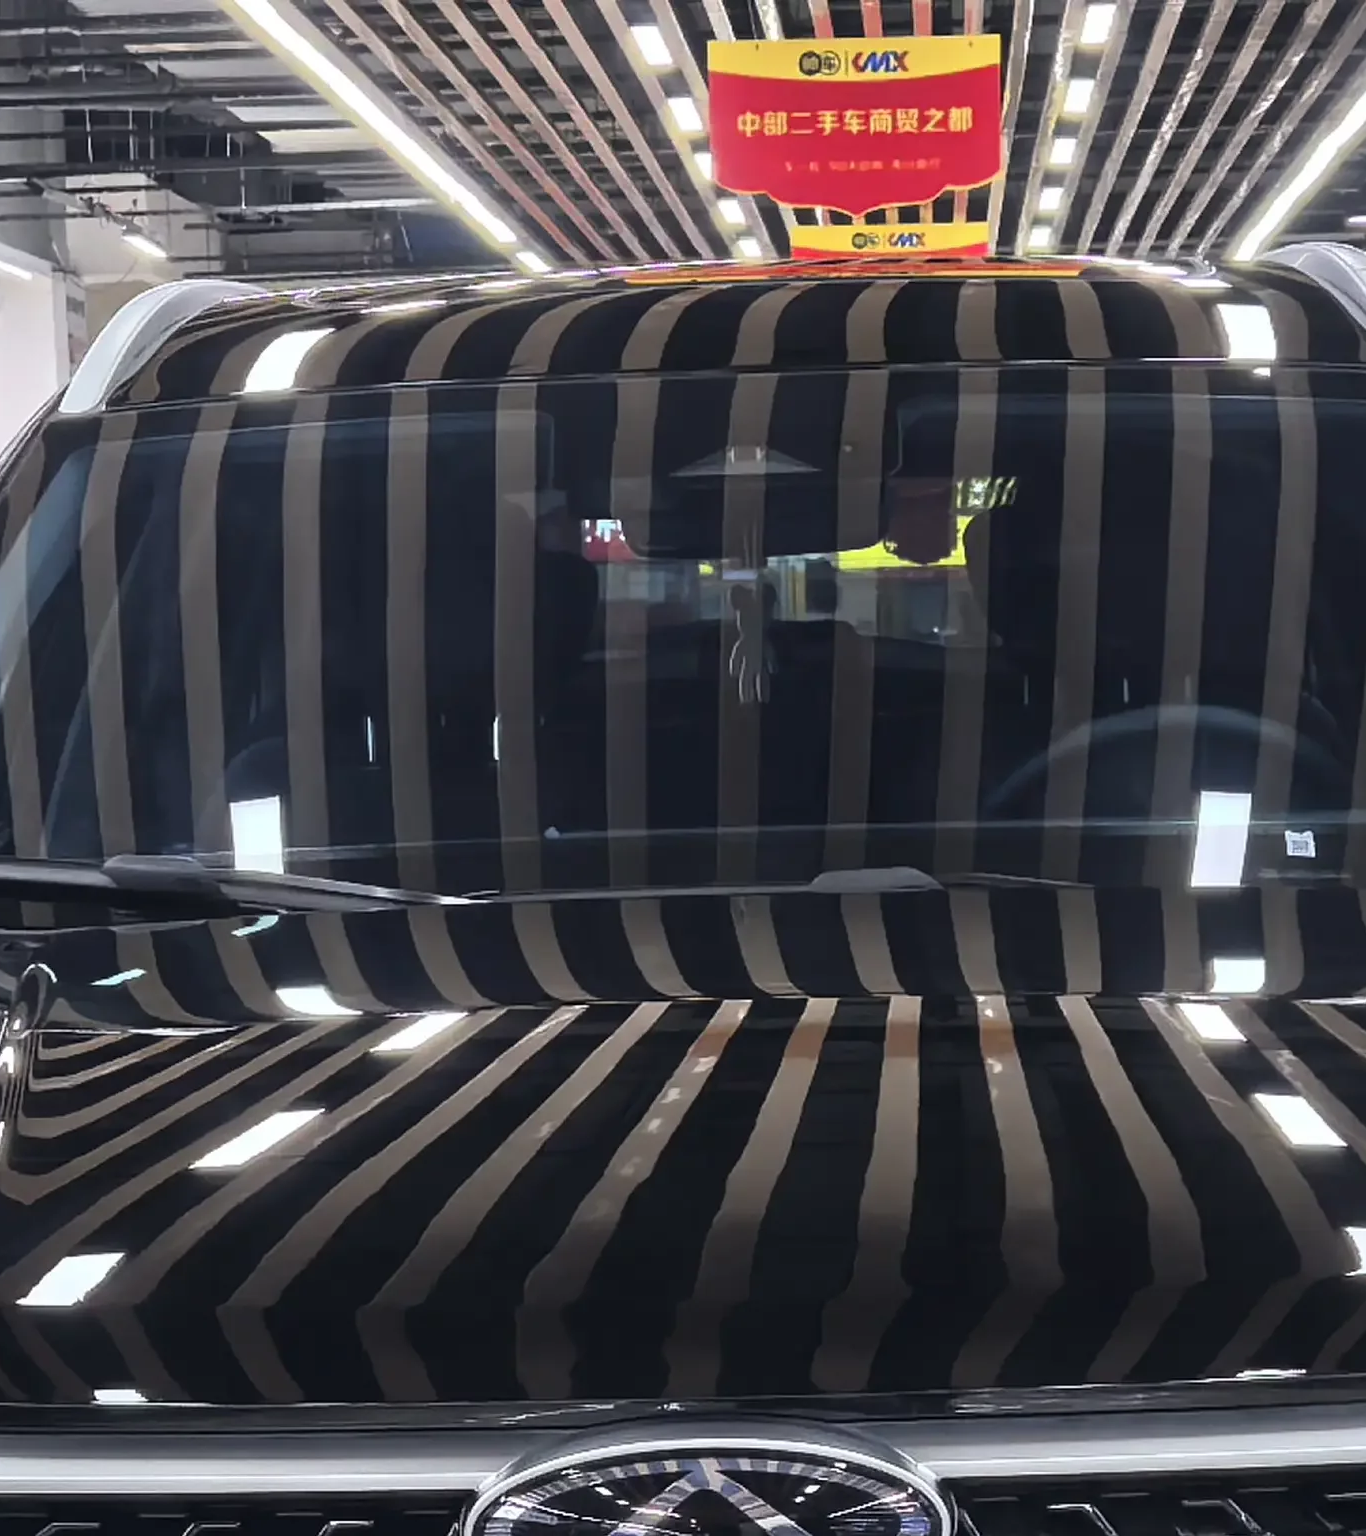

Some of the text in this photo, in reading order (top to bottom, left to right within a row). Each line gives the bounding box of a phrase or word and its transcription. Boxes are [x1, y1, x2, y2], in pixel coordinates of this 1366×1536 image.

[737, 106, 974, 138] 中部二手车商贸之都
